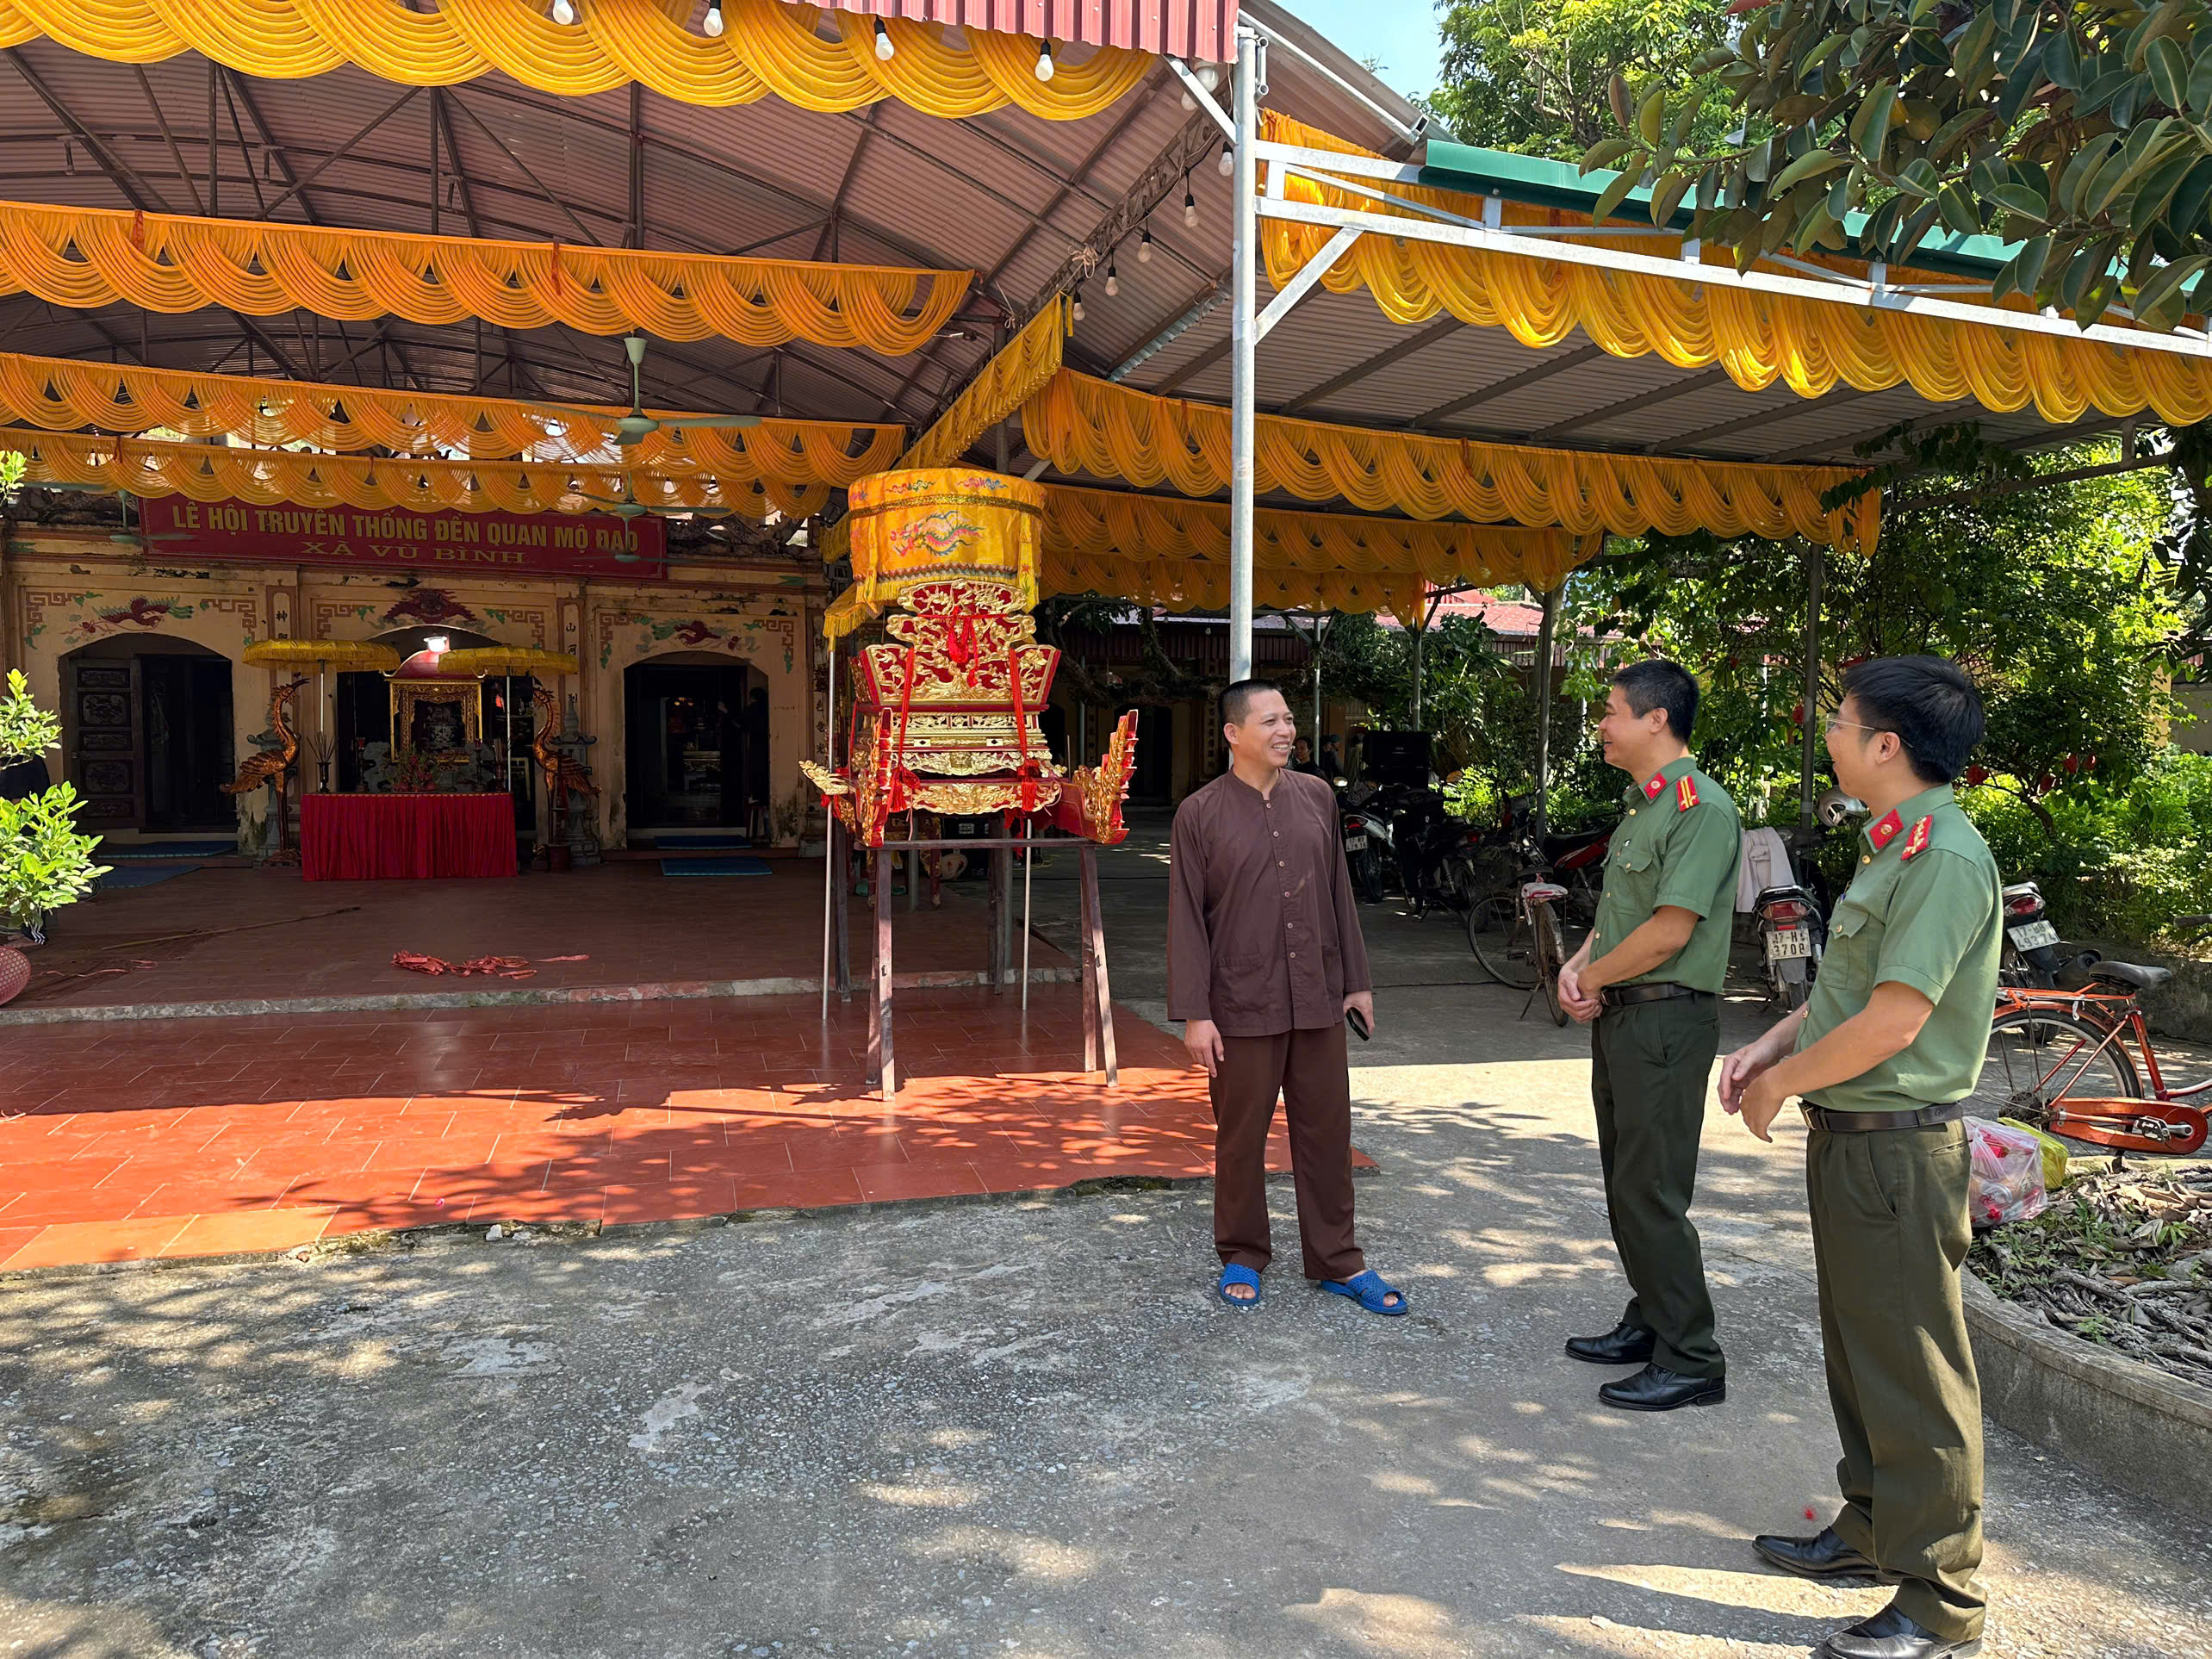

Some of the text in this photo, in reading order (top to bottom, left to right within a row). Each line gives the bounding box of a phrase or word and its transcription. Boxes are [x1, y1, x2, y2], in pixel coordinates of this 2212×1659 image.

[207, 503, 249, 536] HỘI
[351, 509, 428, 541] THỐNG
[434, 513, 479, 543] ĐỀN
[487, 522, 547, 548] QUAN
[554, 523, 589, 554] MỘ
[301, 540, 525, 564] XÃ VŨ BÌNH
